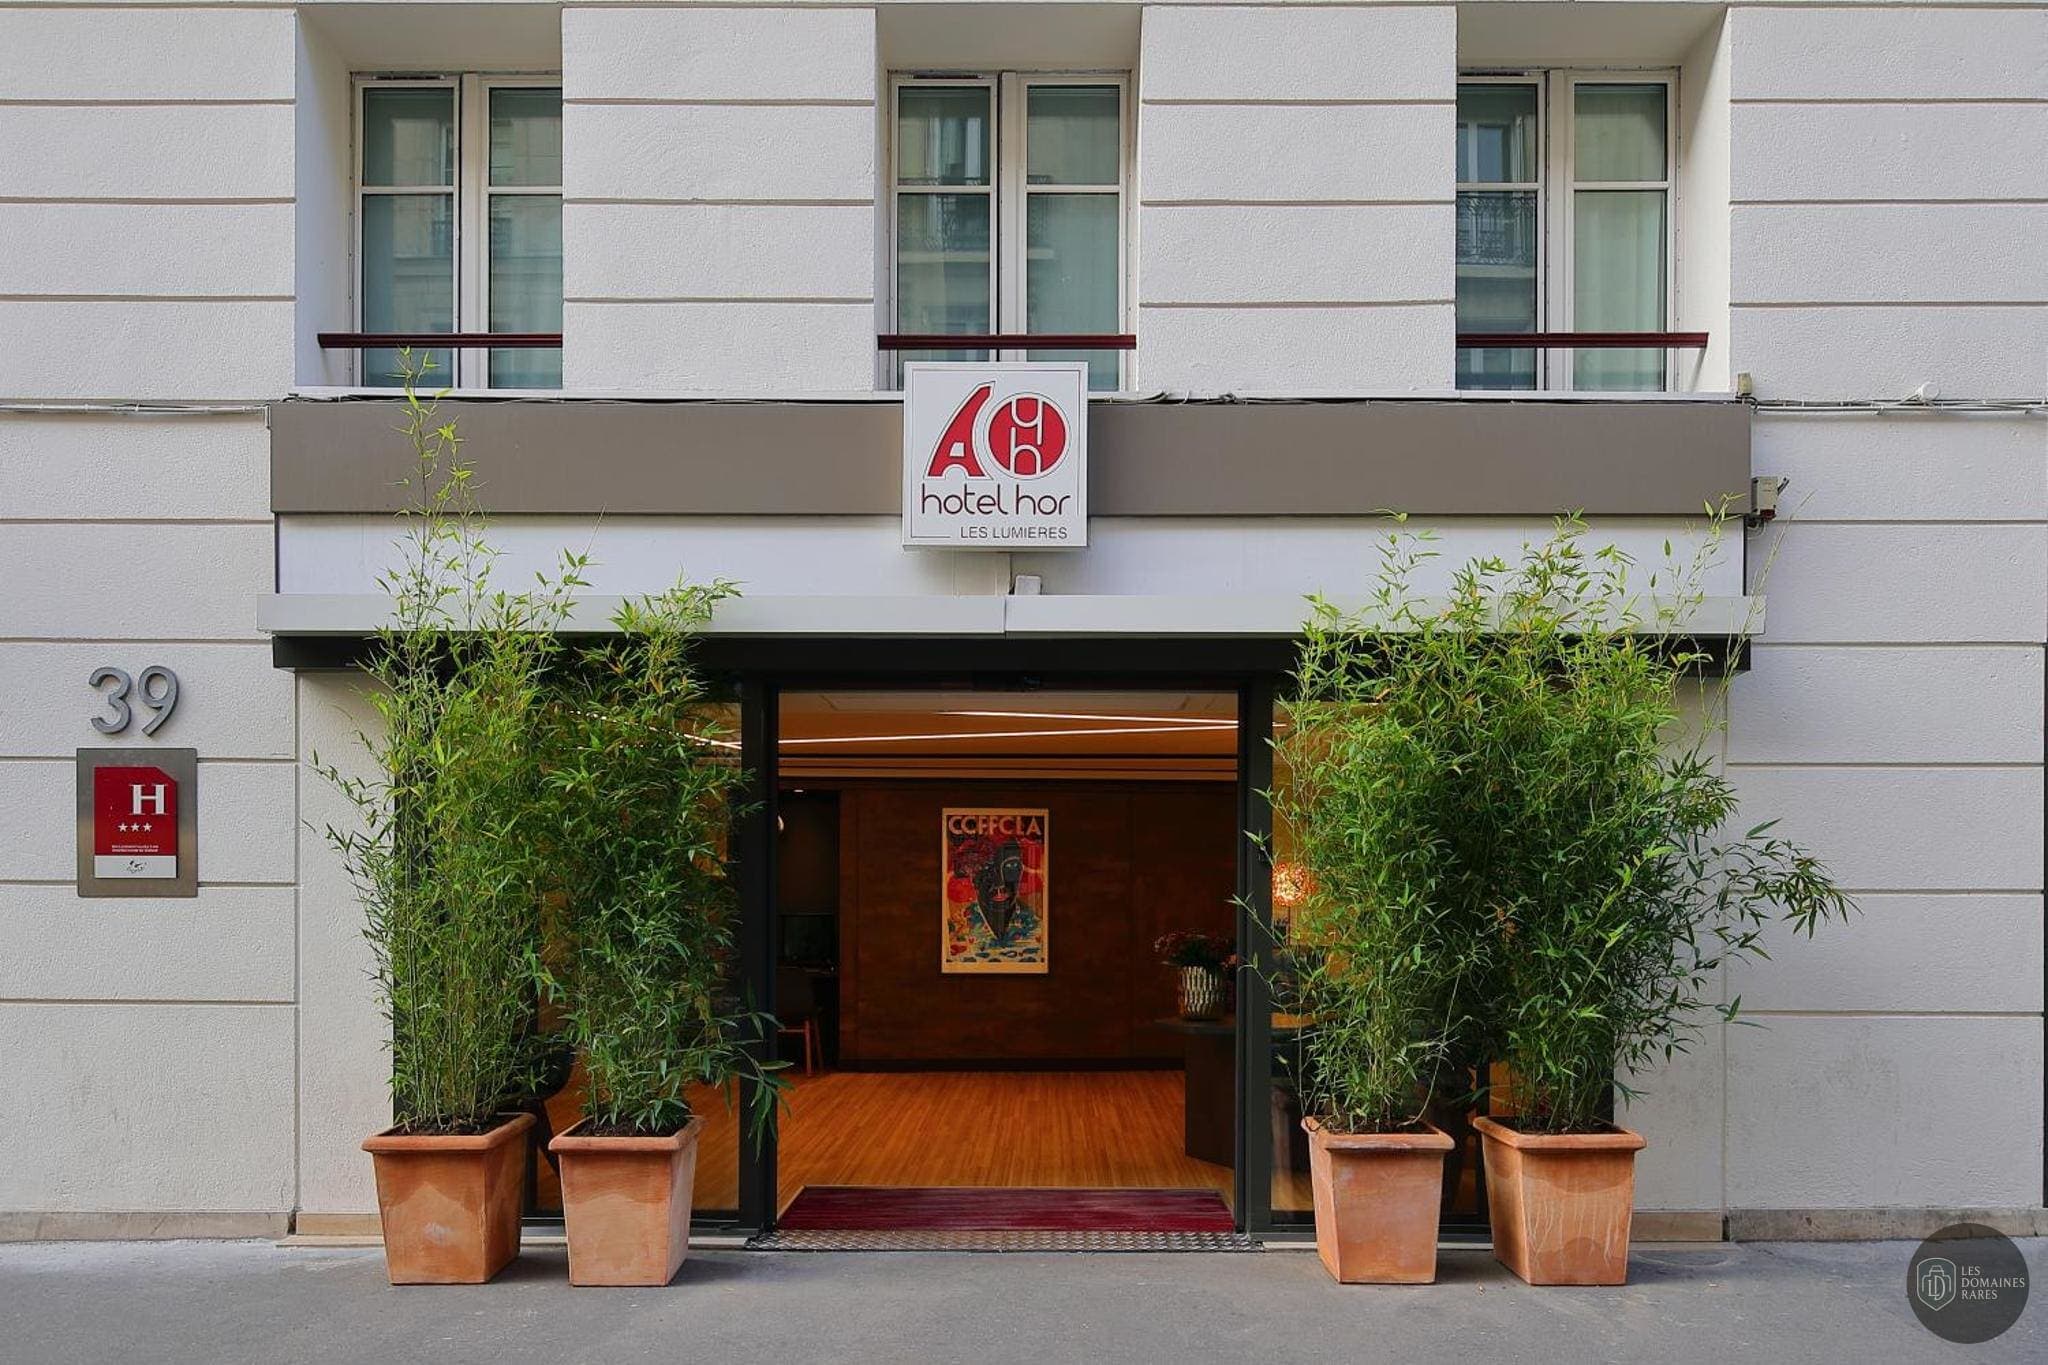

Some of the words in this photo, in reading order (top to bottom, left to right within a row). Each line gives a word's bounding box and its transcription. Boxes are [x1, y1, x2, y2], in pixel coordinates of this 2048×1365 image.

[922, 483, 1009, 515] hotel
[1016, 484, 1071, 515] hor
[960, 527, 988, 539] LES
[993, 527, 1068, 539] LUMIERES
[89, 666, 179, 736] 39
[129, 783, 168, 815] H
